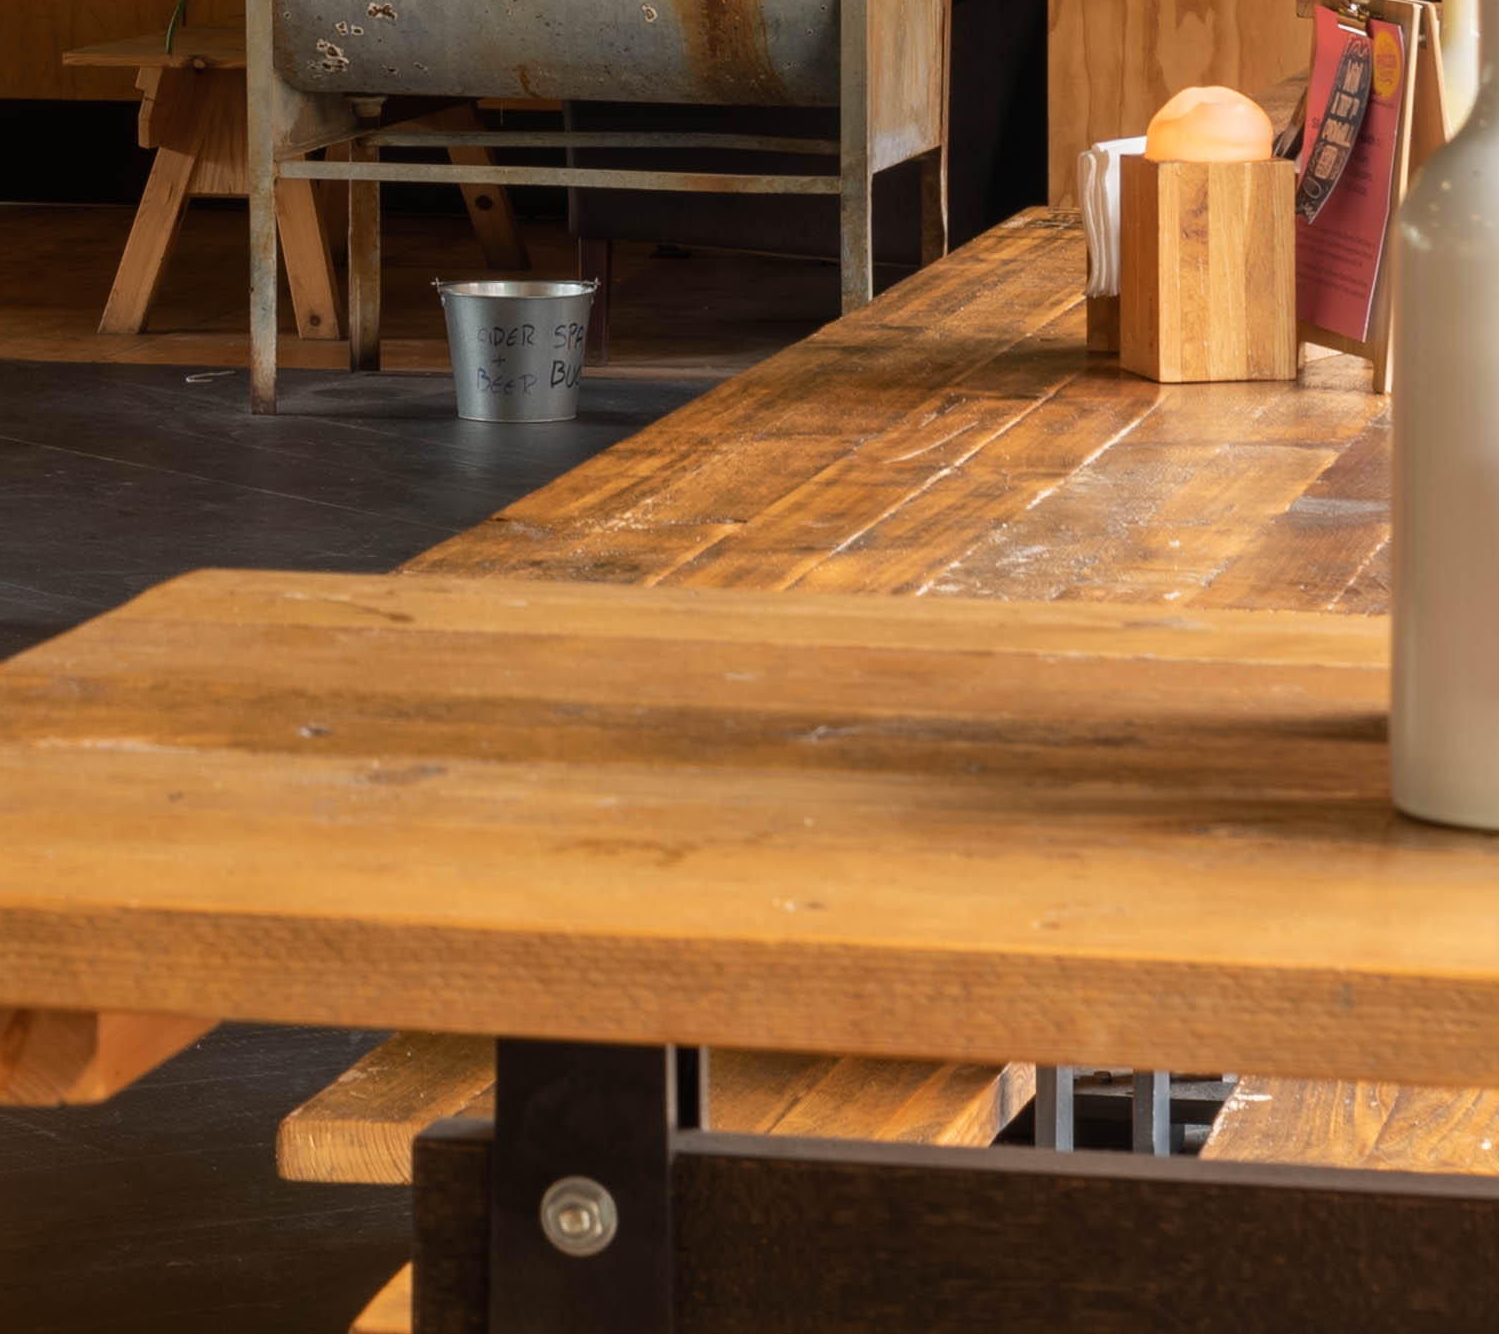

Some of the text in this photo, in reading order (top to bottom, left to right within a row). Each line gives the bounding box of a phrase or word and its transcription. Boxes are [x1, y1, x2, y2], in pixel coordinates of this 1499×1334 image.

[477, 322, 584, 349] CIDER SPA
[476, 367, 538, 395] BEER
